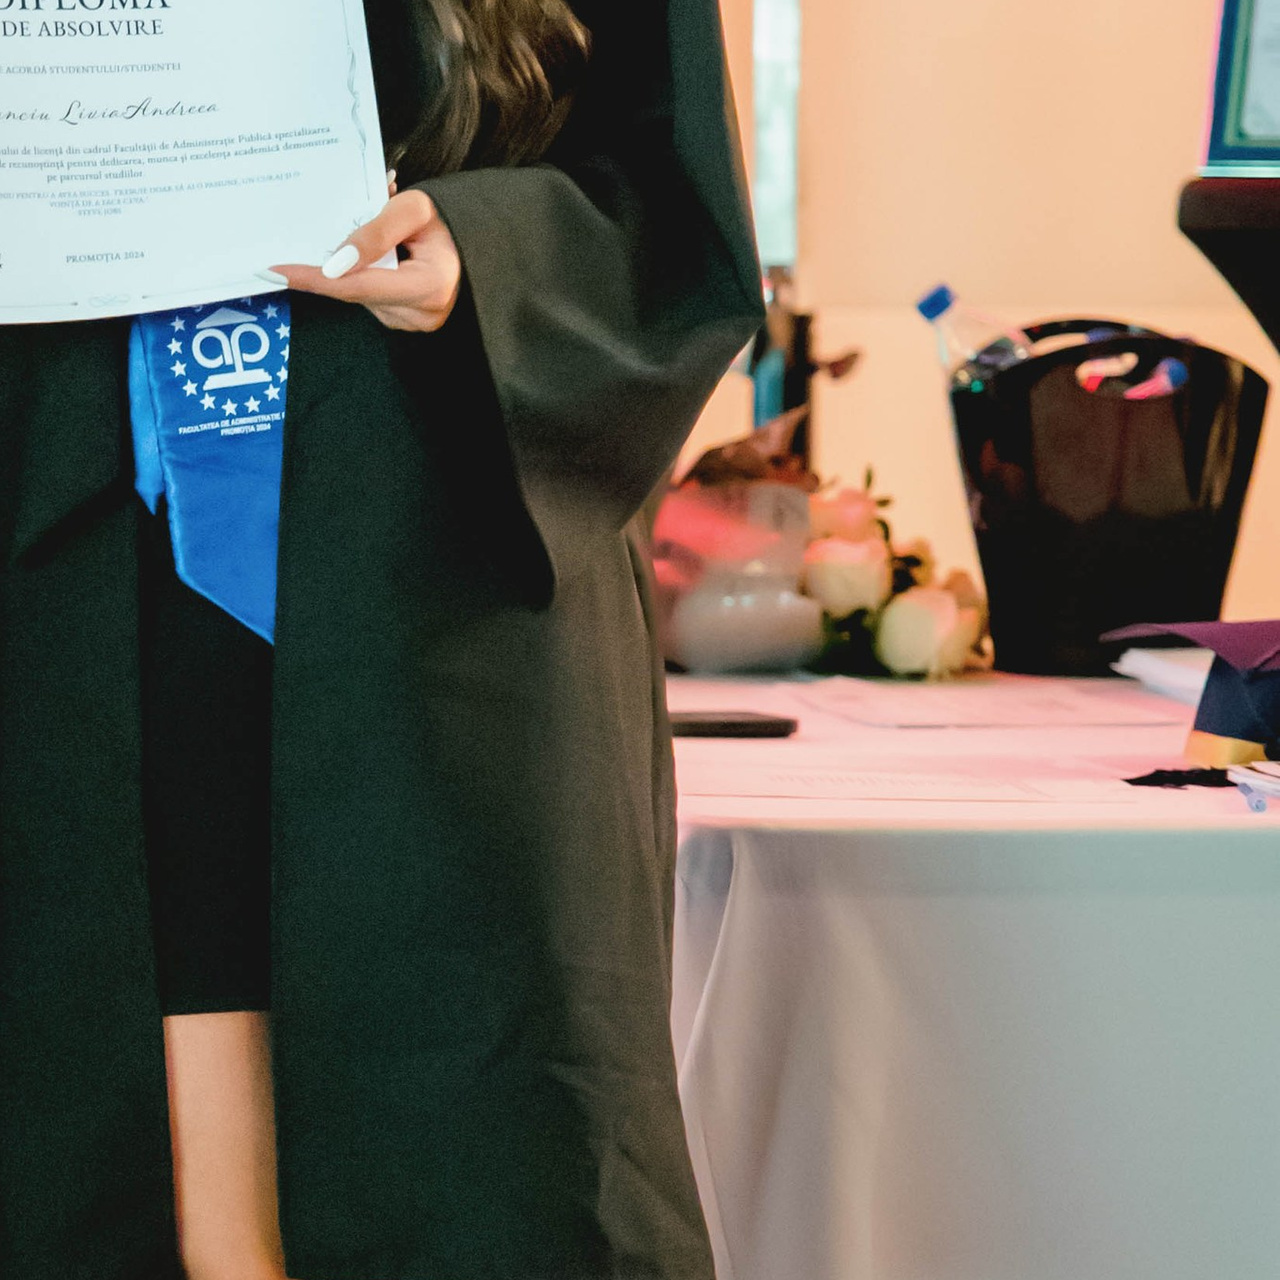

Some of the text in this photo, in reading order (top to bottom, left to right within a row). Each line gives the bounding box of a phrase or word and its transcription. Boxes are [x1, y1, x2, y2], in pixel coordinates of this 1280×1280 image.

[2, 19, 164, 37] DE ABSOLVIRE
[58, 100, 121, 125] Livia
[120, 96, 220, 120] Andreea
[21, 145, 31, 155] de
[65, 145, 81, 155] din
[82, 144, 111, 154] cadrul
[159, 140, 170, 150] de
[66, 160, 98, 171] pentru
[147, 156, 178, 164] munca
[282, 137, 339, 150] demonstrate
[46, 169, 143, 184] pe parcursul studiilor
[124, 250, 145, 260] 2024
